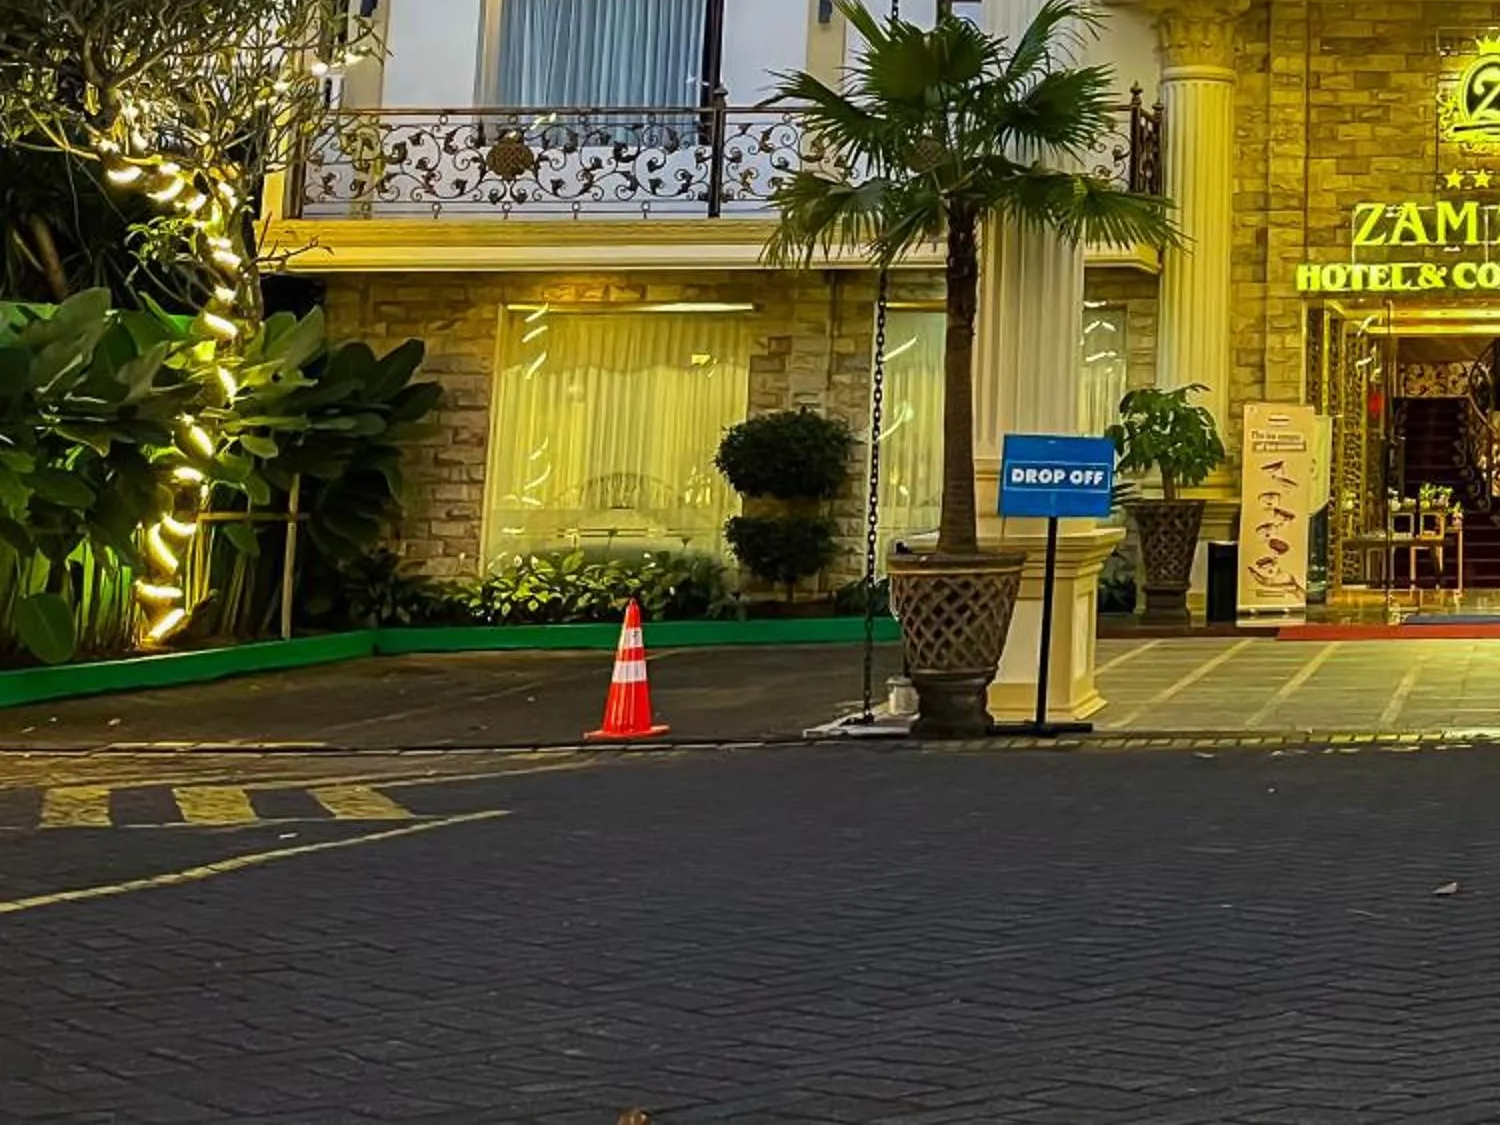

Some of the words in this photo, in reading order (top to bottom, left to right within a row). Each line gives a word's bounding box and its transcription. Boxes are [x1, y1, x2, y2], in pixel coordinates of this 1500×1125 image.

[1353, 201, 1480, 245] ZAM
[1297, 263, 1412, 291] HOTEL
[1418, 262, 1447, 290] &
[1011, 468, 1066, 484] DROP
[1069, 470, 1104, 485] OFF
